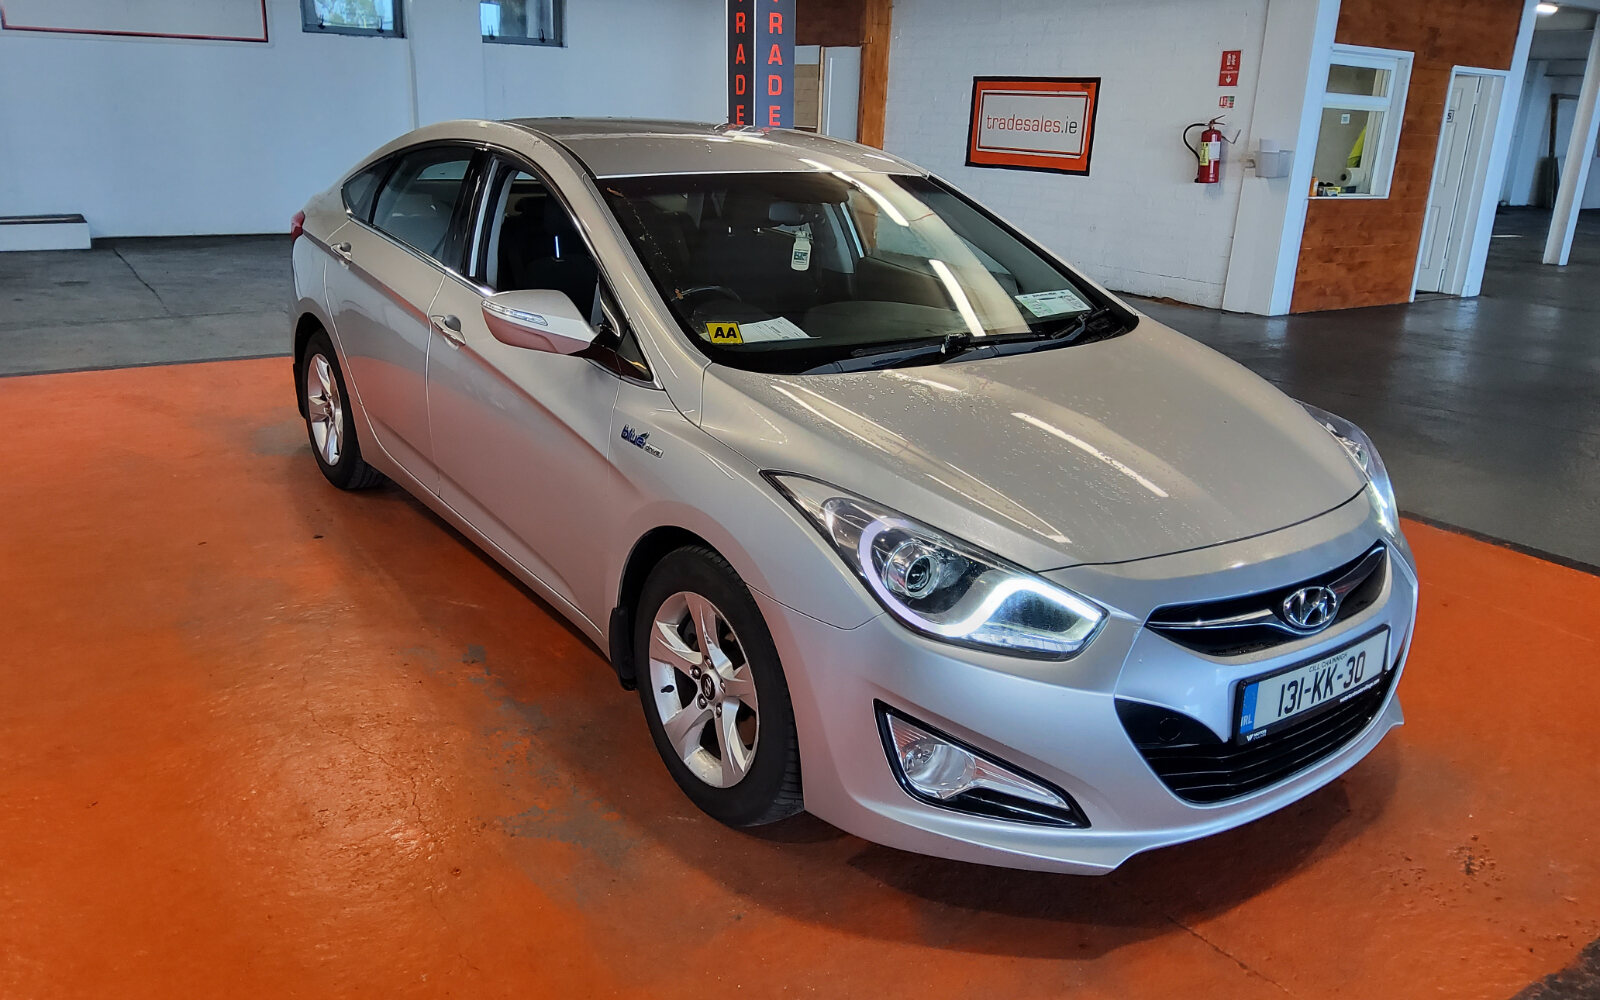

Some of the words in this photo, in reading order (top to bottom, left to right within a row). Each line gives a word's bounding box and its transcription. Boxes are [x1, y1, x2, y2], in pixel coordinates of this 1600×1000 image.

[735, 0, 746, 125] RADE
[767, 0, 783, 126] RADE
[986, 113, 1078, 134] tradesales.ie
[713, 326, 737, 339] AA
[1277, 650, 1366, 718] 131-KK-30
[1240, 713, 1253, 728] IRL
